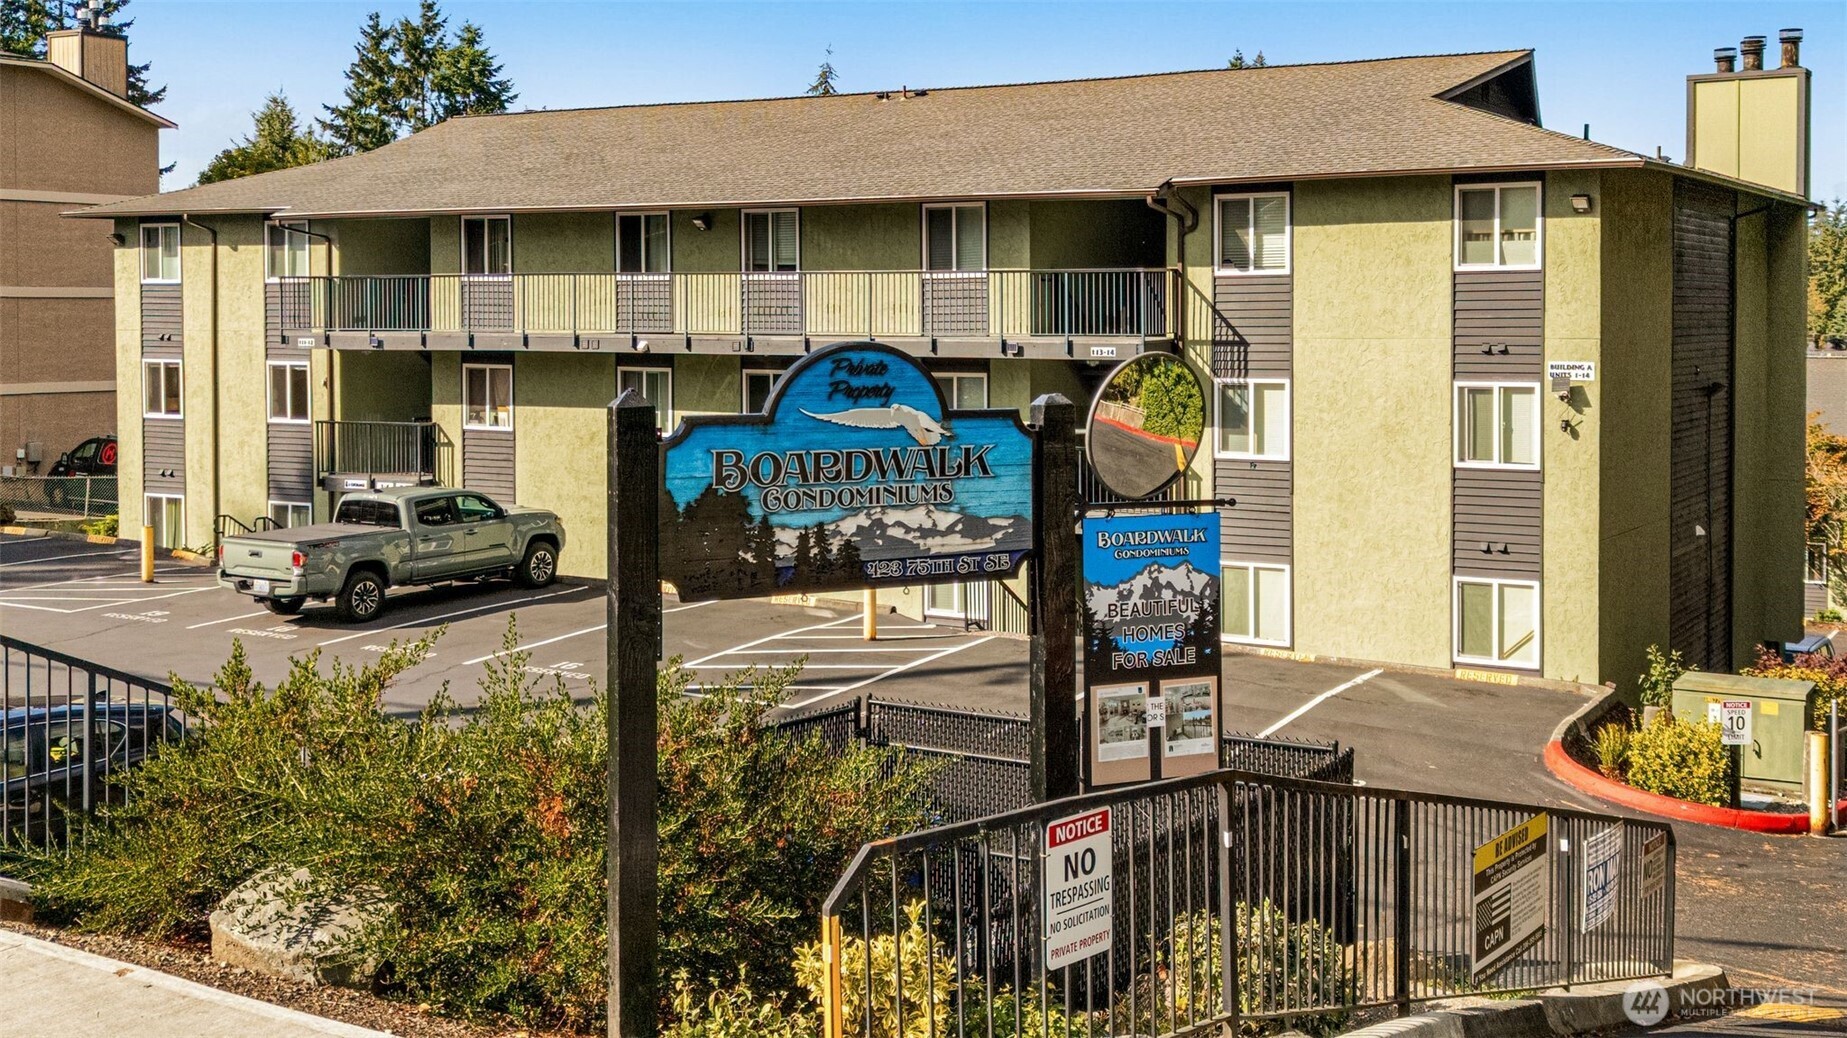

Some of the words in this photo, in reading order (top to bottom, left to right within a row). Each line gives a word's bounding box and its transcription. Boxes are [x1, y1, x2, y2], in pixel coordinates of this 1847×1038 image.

[829, 357, 889, 377] Private
[1549, 371, 1572, 379] UNITS
[827, 380, 897, 406] Property
[711, 444, 996, 492] BOARDWALK
[760, 480, 955, 513] CONDOMINIUMS
[1097, 527, 1208, 549] BOARDWALK
[1114, 546, 1190, 560] CONDOMINIUMS
[867, 560, 903, 578] 423
[906, 558, 956, 576] 75TH
[956, 555, 981, 574] ST
[983, 553, 1011, 571] SE
[1107, 596, 1201, 619] BEAUTIFUL
[1122, 622, 1187, 644] HOMES
[1111, 651, 1149, 670] FOR
[1152, 647, 1197, 667] SALE
[1460, 670, 1512, 685] RESERVED
[1150, 701, 1164, 711] THE
[1728, 716, 1745, 730] 10
[1055, 815, 1103, 844] NOTICE
[1495, 840, 1503, 858] BE
[1504, 826, 1529, 854] ADVISED
[1064, 847, 1097, 882] NO
[1050, 875, 1110, 910] TRESPASSING
[1050, 921, 1062, 935] NO
[1063, 903, 1110, 930] SOLICITATION
[1050, 941, 1078, 960] PRIVATE
[1079, 929, 1111, 950] PROPERTY
[1484, 926, 1504, 950] CAPN
